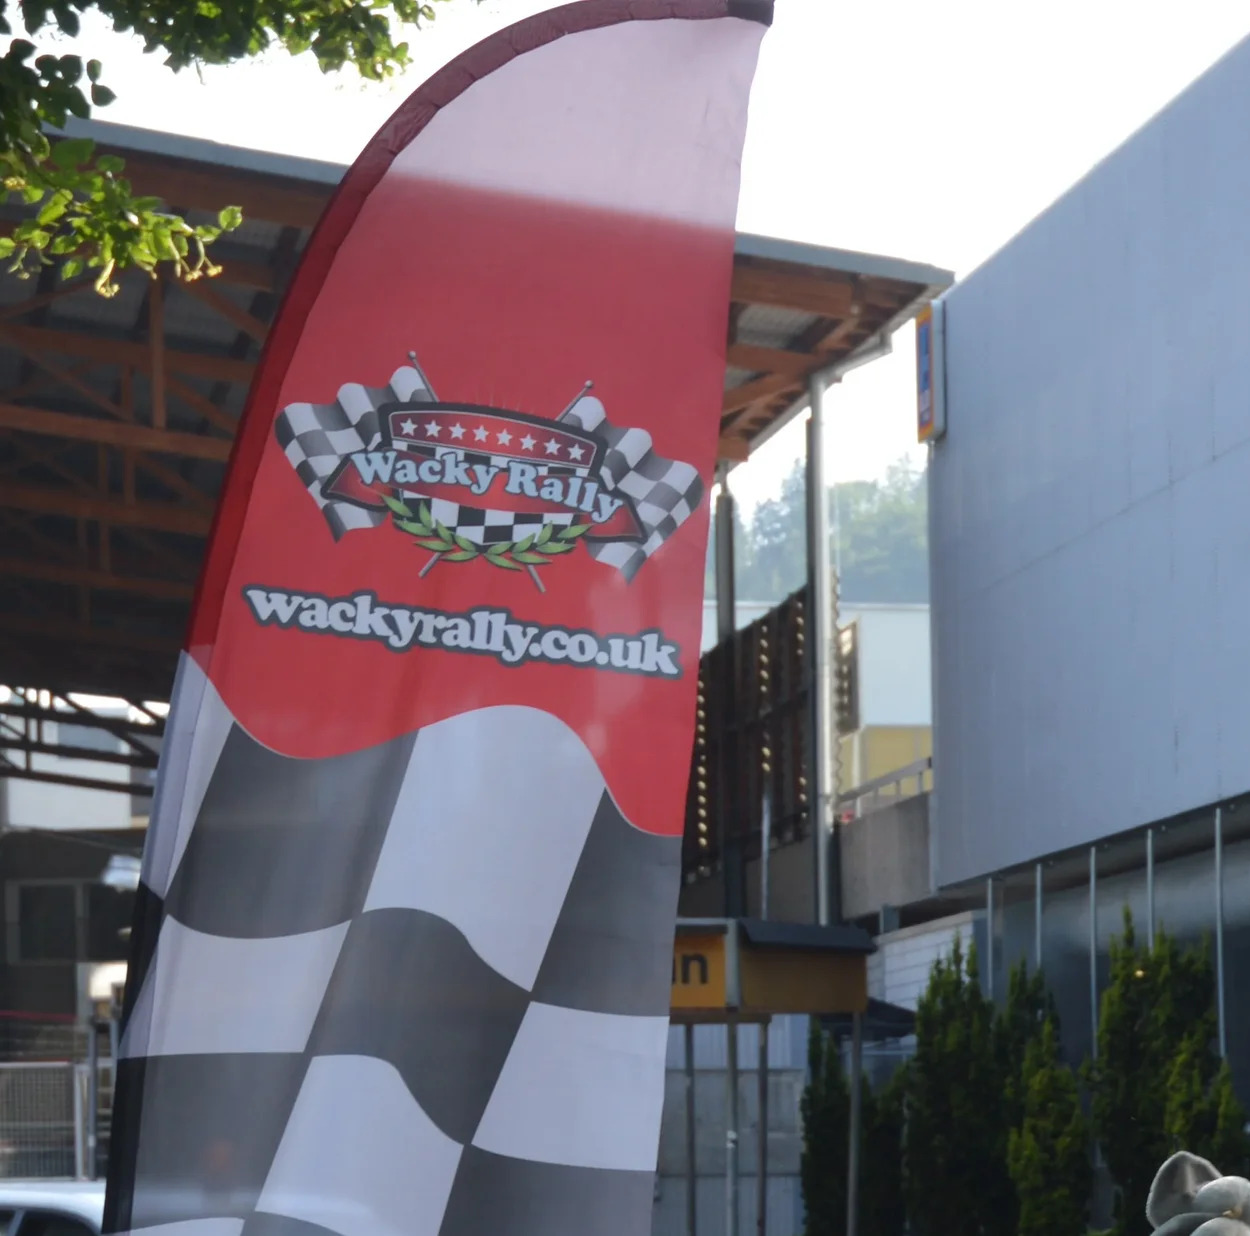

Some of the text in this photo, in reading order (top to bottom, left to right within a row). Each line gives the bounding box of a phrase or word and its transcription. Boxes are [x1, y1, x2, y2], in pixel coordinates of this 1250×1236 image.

[350, 450, 624, 523] Wacky Rally
[246, 589, 680, 675] wackyrally.co.uk
